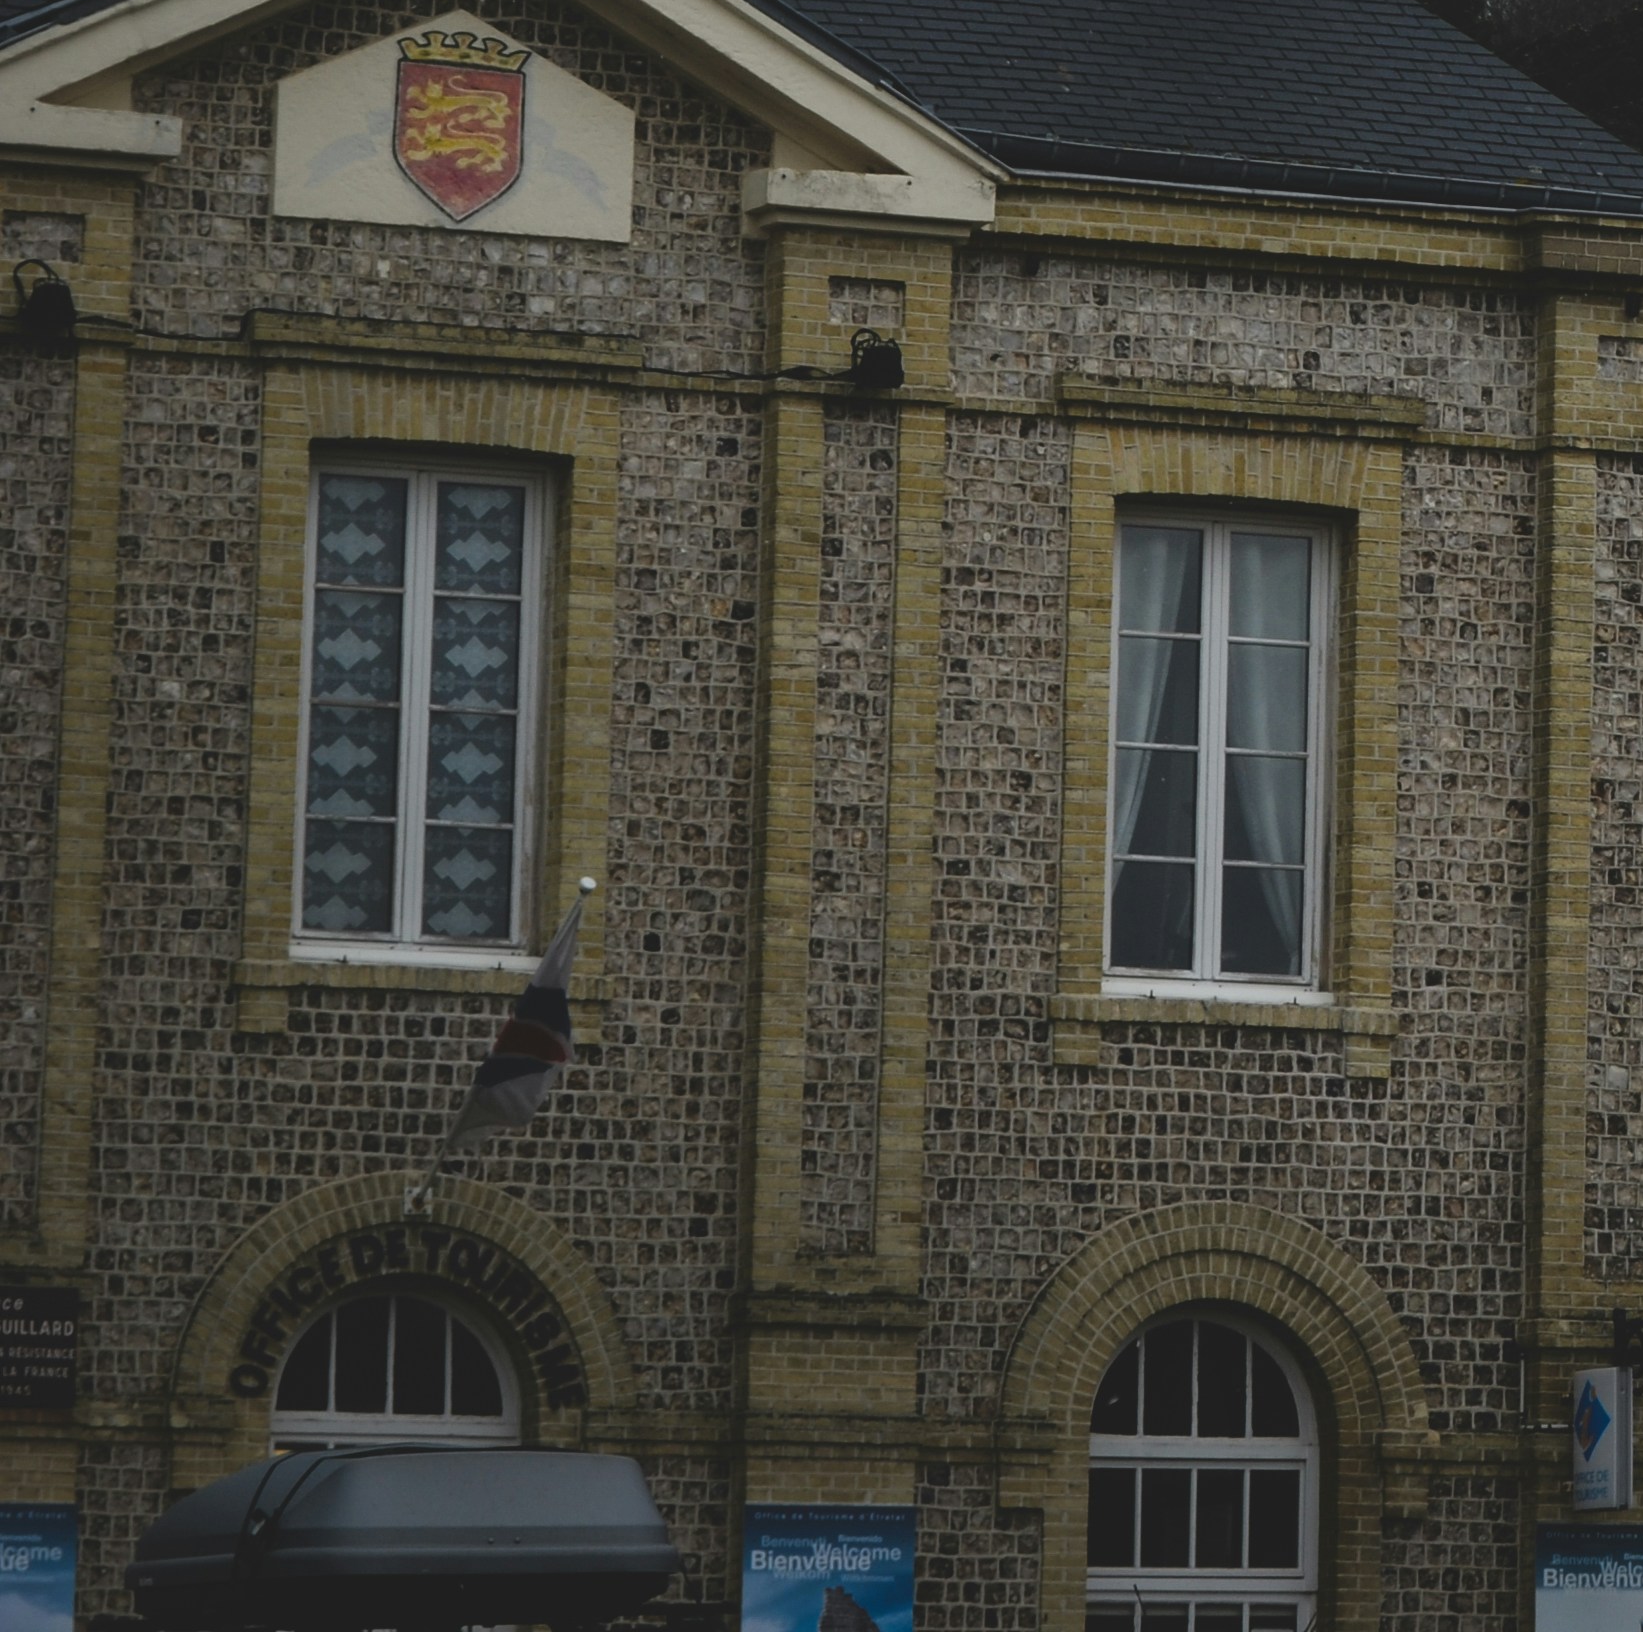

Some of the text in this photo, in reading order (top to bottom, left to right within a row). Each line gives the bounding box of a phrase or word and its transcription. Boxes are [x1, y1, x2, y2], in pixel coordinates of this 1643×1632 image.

[0, 1319, 74, 1337] UILLARD
[229, 1228, 587, 1410] OFFICE DE TOURISME
[751, 1549, 872, 1571] Bienvenue
[812, 1543, 902, 1561] Welcome
